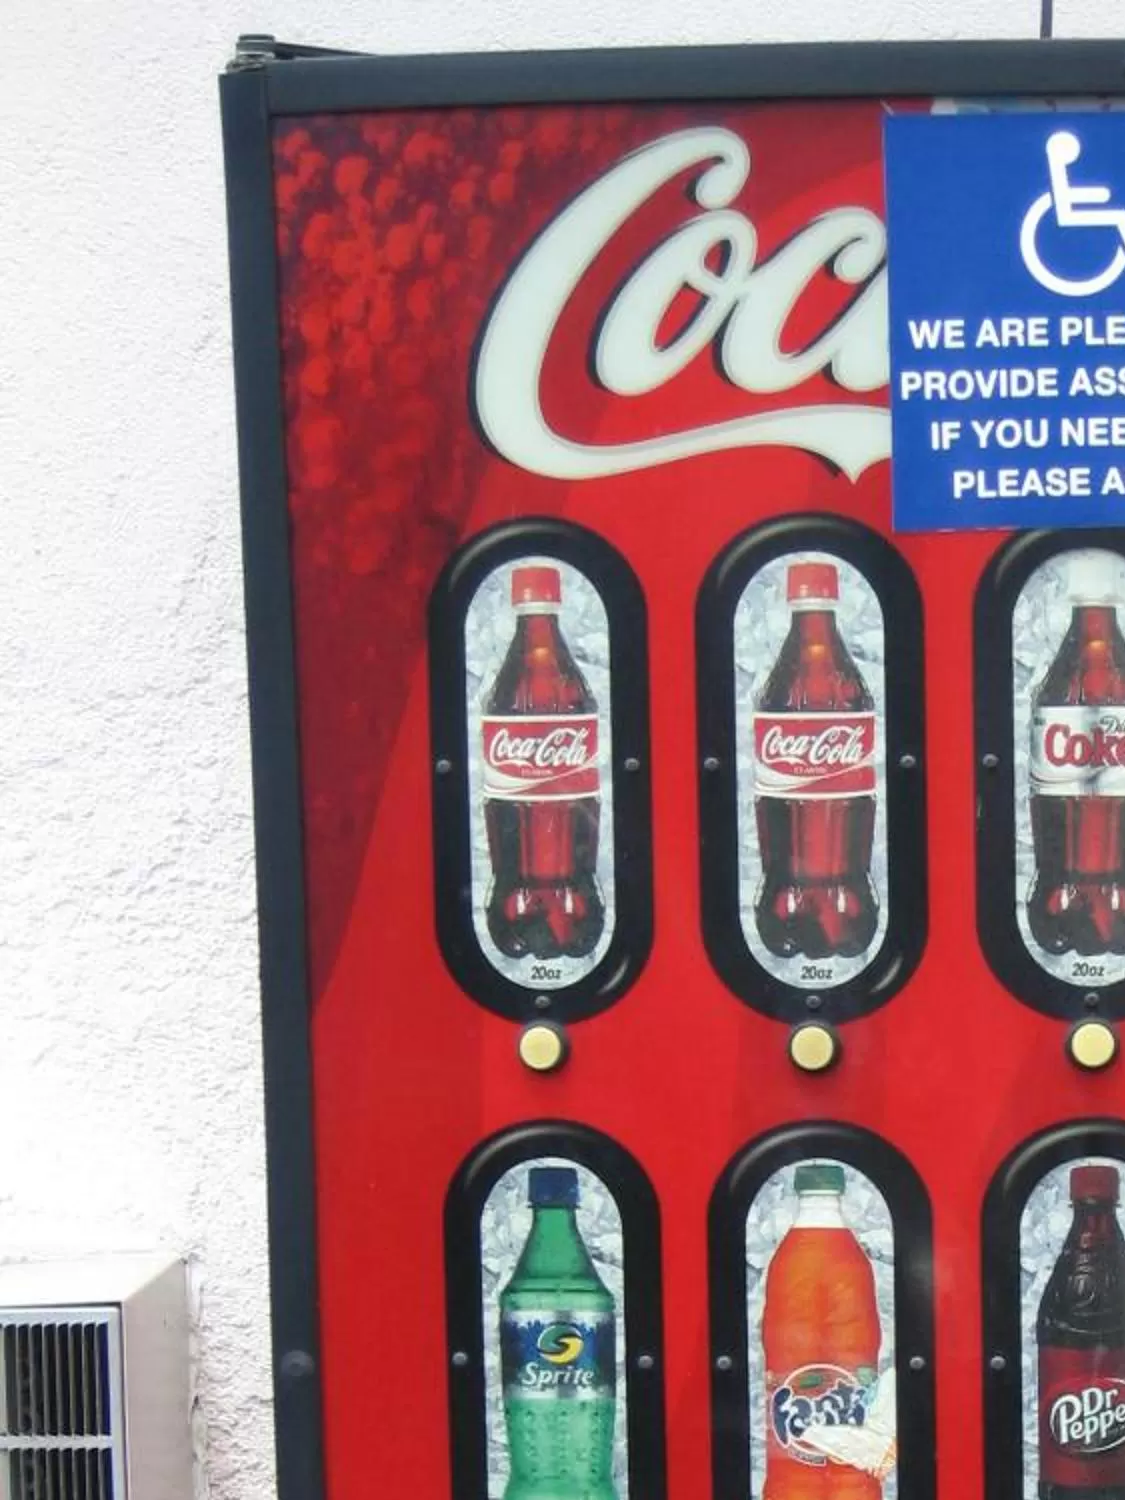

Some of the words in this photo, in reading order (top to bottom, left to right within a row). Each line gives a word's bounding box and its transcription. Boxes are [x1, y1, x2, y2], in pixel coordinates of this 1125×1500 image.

[908, 319, 965, 349] WE
[975, 317, 1049, 347] ARE
[900, 367, 1059, 401] PROVIDE
[930, 421, 961, 450] IF
[971, 419, 1049, 449] YOU
[953, 467, 1091, 499] PLEASE
[531, 965, 562, 980] 20oz
[800, 965, 833, 980] 20oz
[1071, 962, 1104, 977] 20oz
[521, 1362, 595, 1390] Sprite
[1082, 1387, 1119, 1417] Dr
